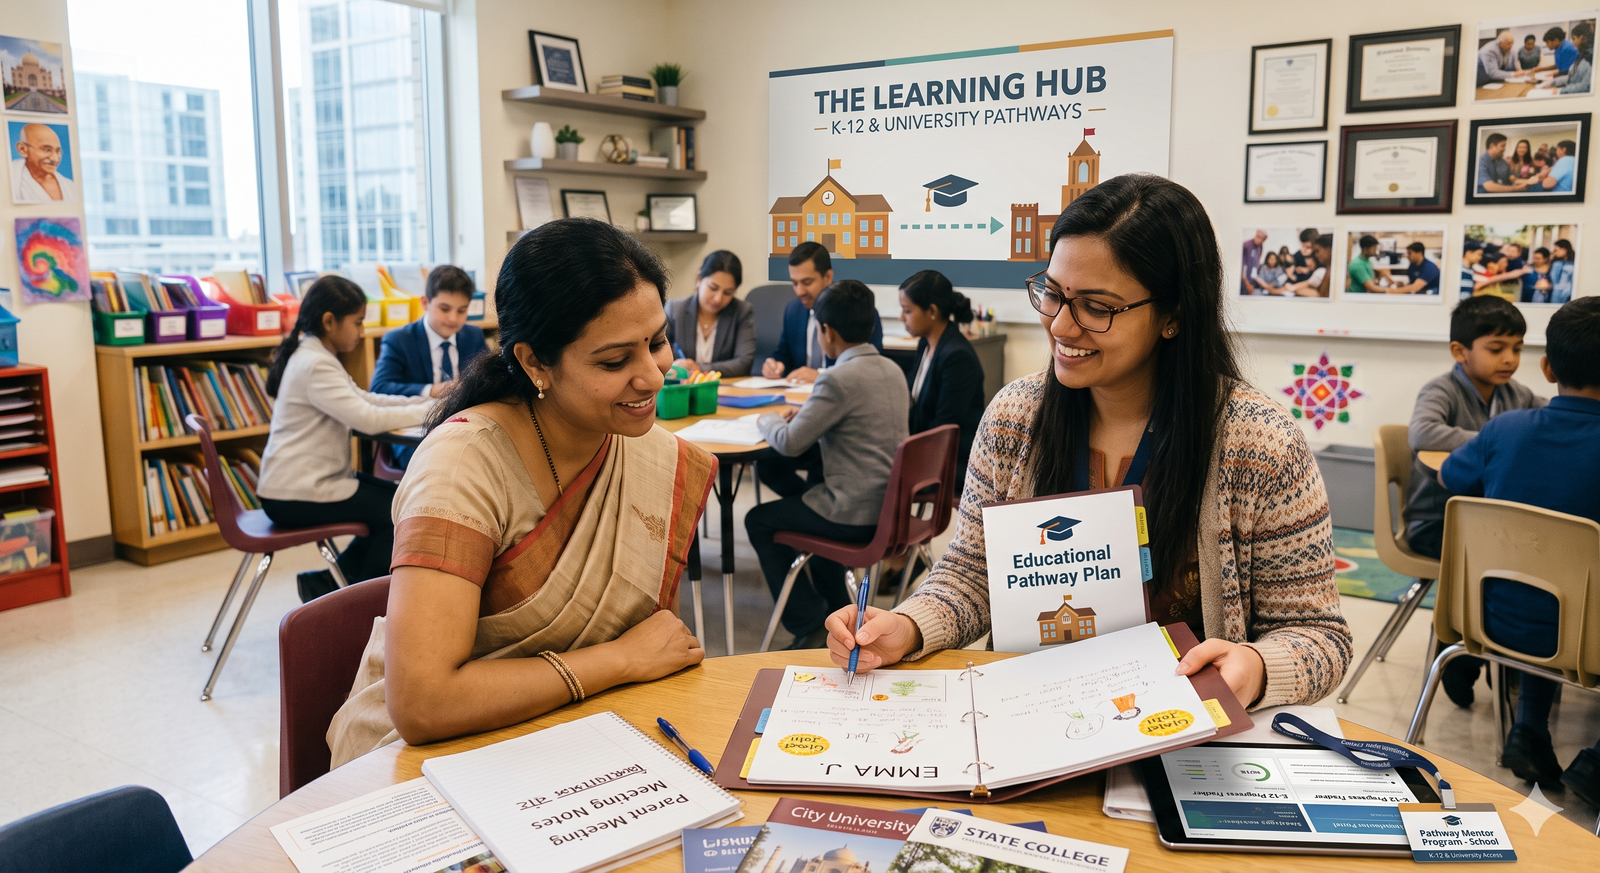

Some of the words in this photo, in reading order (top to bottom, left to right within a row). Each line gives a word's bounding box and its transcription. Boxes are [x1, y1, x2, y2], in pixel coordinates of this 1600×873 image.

[814, 87, 865, 114] THE
[874, 72, 1025, 110] LEARNING
[1036, 65, 1107, 98] HUB
[831, 118, 864, 135] K-12
[868, 118, 880, 133] &
[884, 111, 980, 132] UNIVERSITY
[984, 102, 1082, 125] PATHWAYS
[1013, 544, 1111, 569] Educational
[1007, 570, 1078, 589] Pathway
[1083, 566, 1121, 582] Plan
[820, 762, 842, 775] J.
[854, 765, 938, 778] EMMA
[590, 779, 668, 810] Meeting
[627, 793, 690, 820] Parent
[531, 806, 590, 830] Notes
[549, 815, 628, 846] Meeting
[791, 806, 825, 822] City
[828, 811, 916, 834] University
[964, 827, 1021, 847] STATE
[1024, 841, 1110, 867] COLLEGE
[1419, 829, 1460, 839] Pathway
[1461, 829, 1494, 837] Mentor
[1422, 838, 1463, 847] Program
